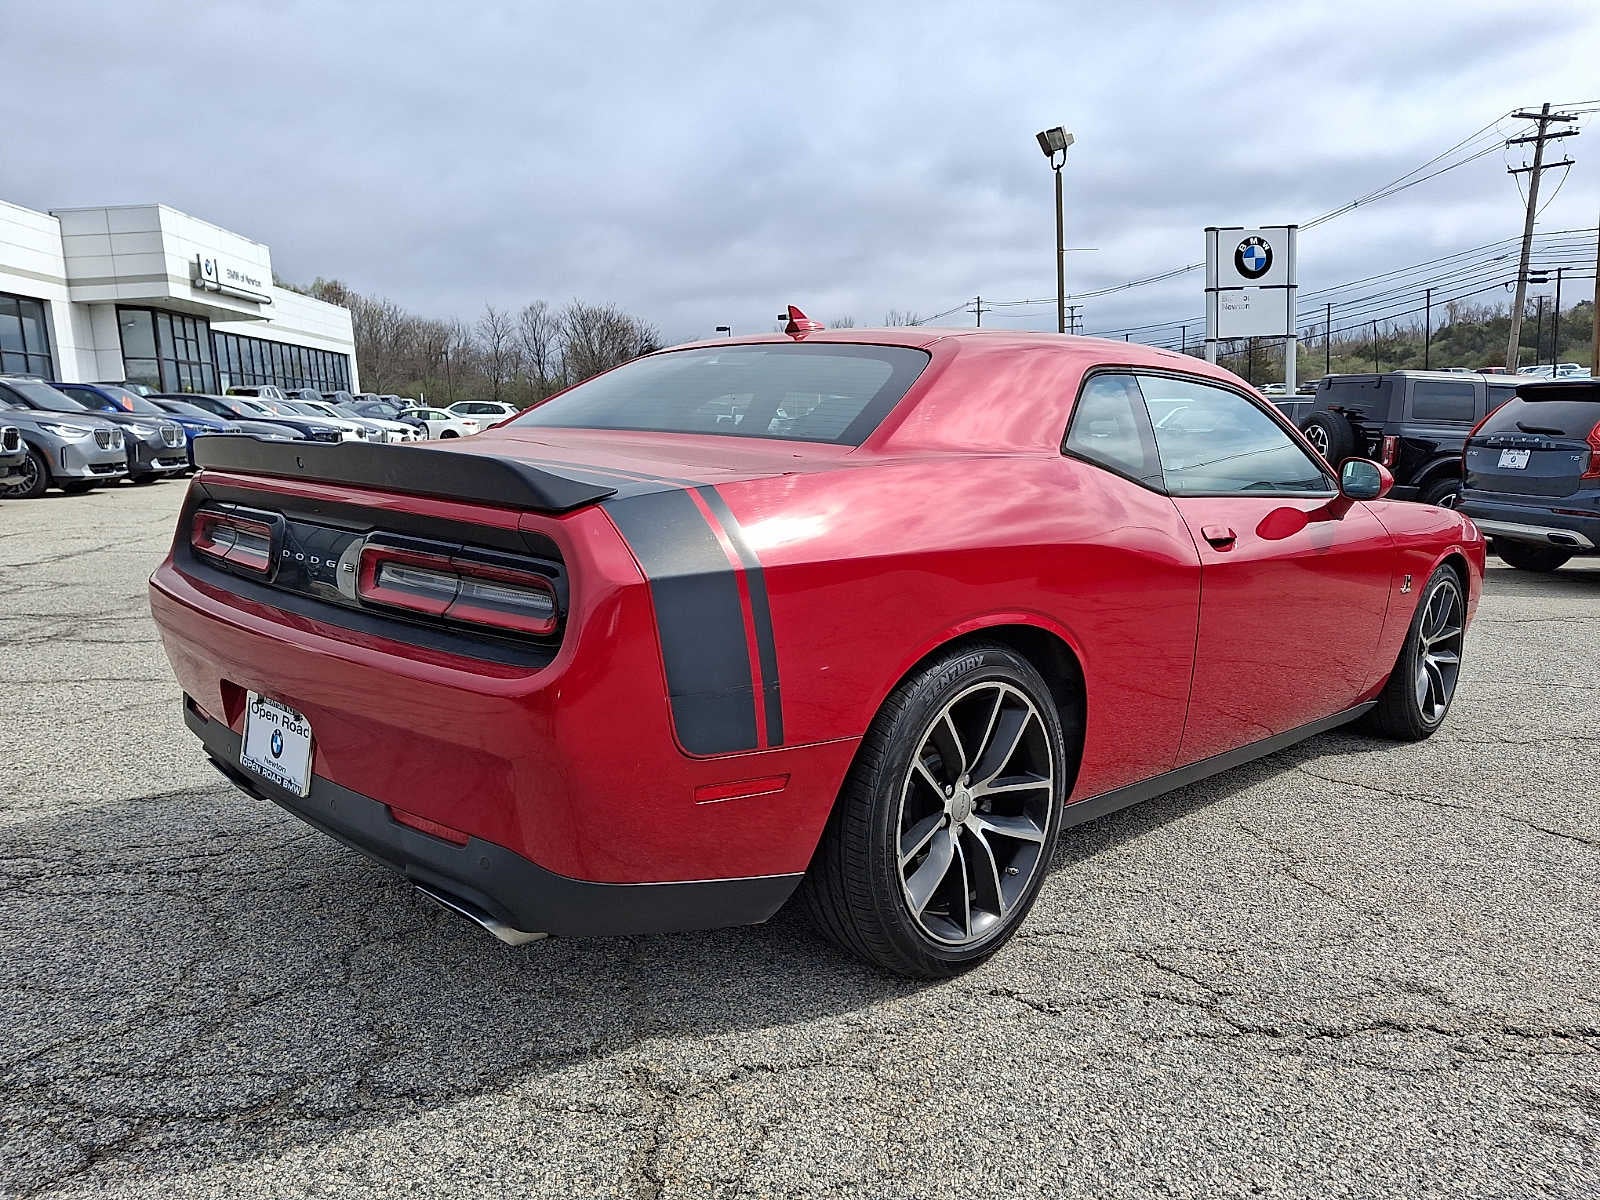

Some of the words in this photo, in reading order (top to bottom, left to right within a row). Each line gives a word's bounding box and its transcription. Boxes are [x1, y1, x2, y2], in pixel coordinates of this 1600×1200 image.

[1238, 237, 1270, 252] BMW
[282, 549, 353, 572] DODGE
[251, 702, 279, 725] Open
[281, 714, 309, 739] Road
[263, 755, 288, 774] Newton
[242, 757, 261, 774] OPEN
[262, 767, 282, 785] ROAD
[282, 778, 301, 796] BMW
